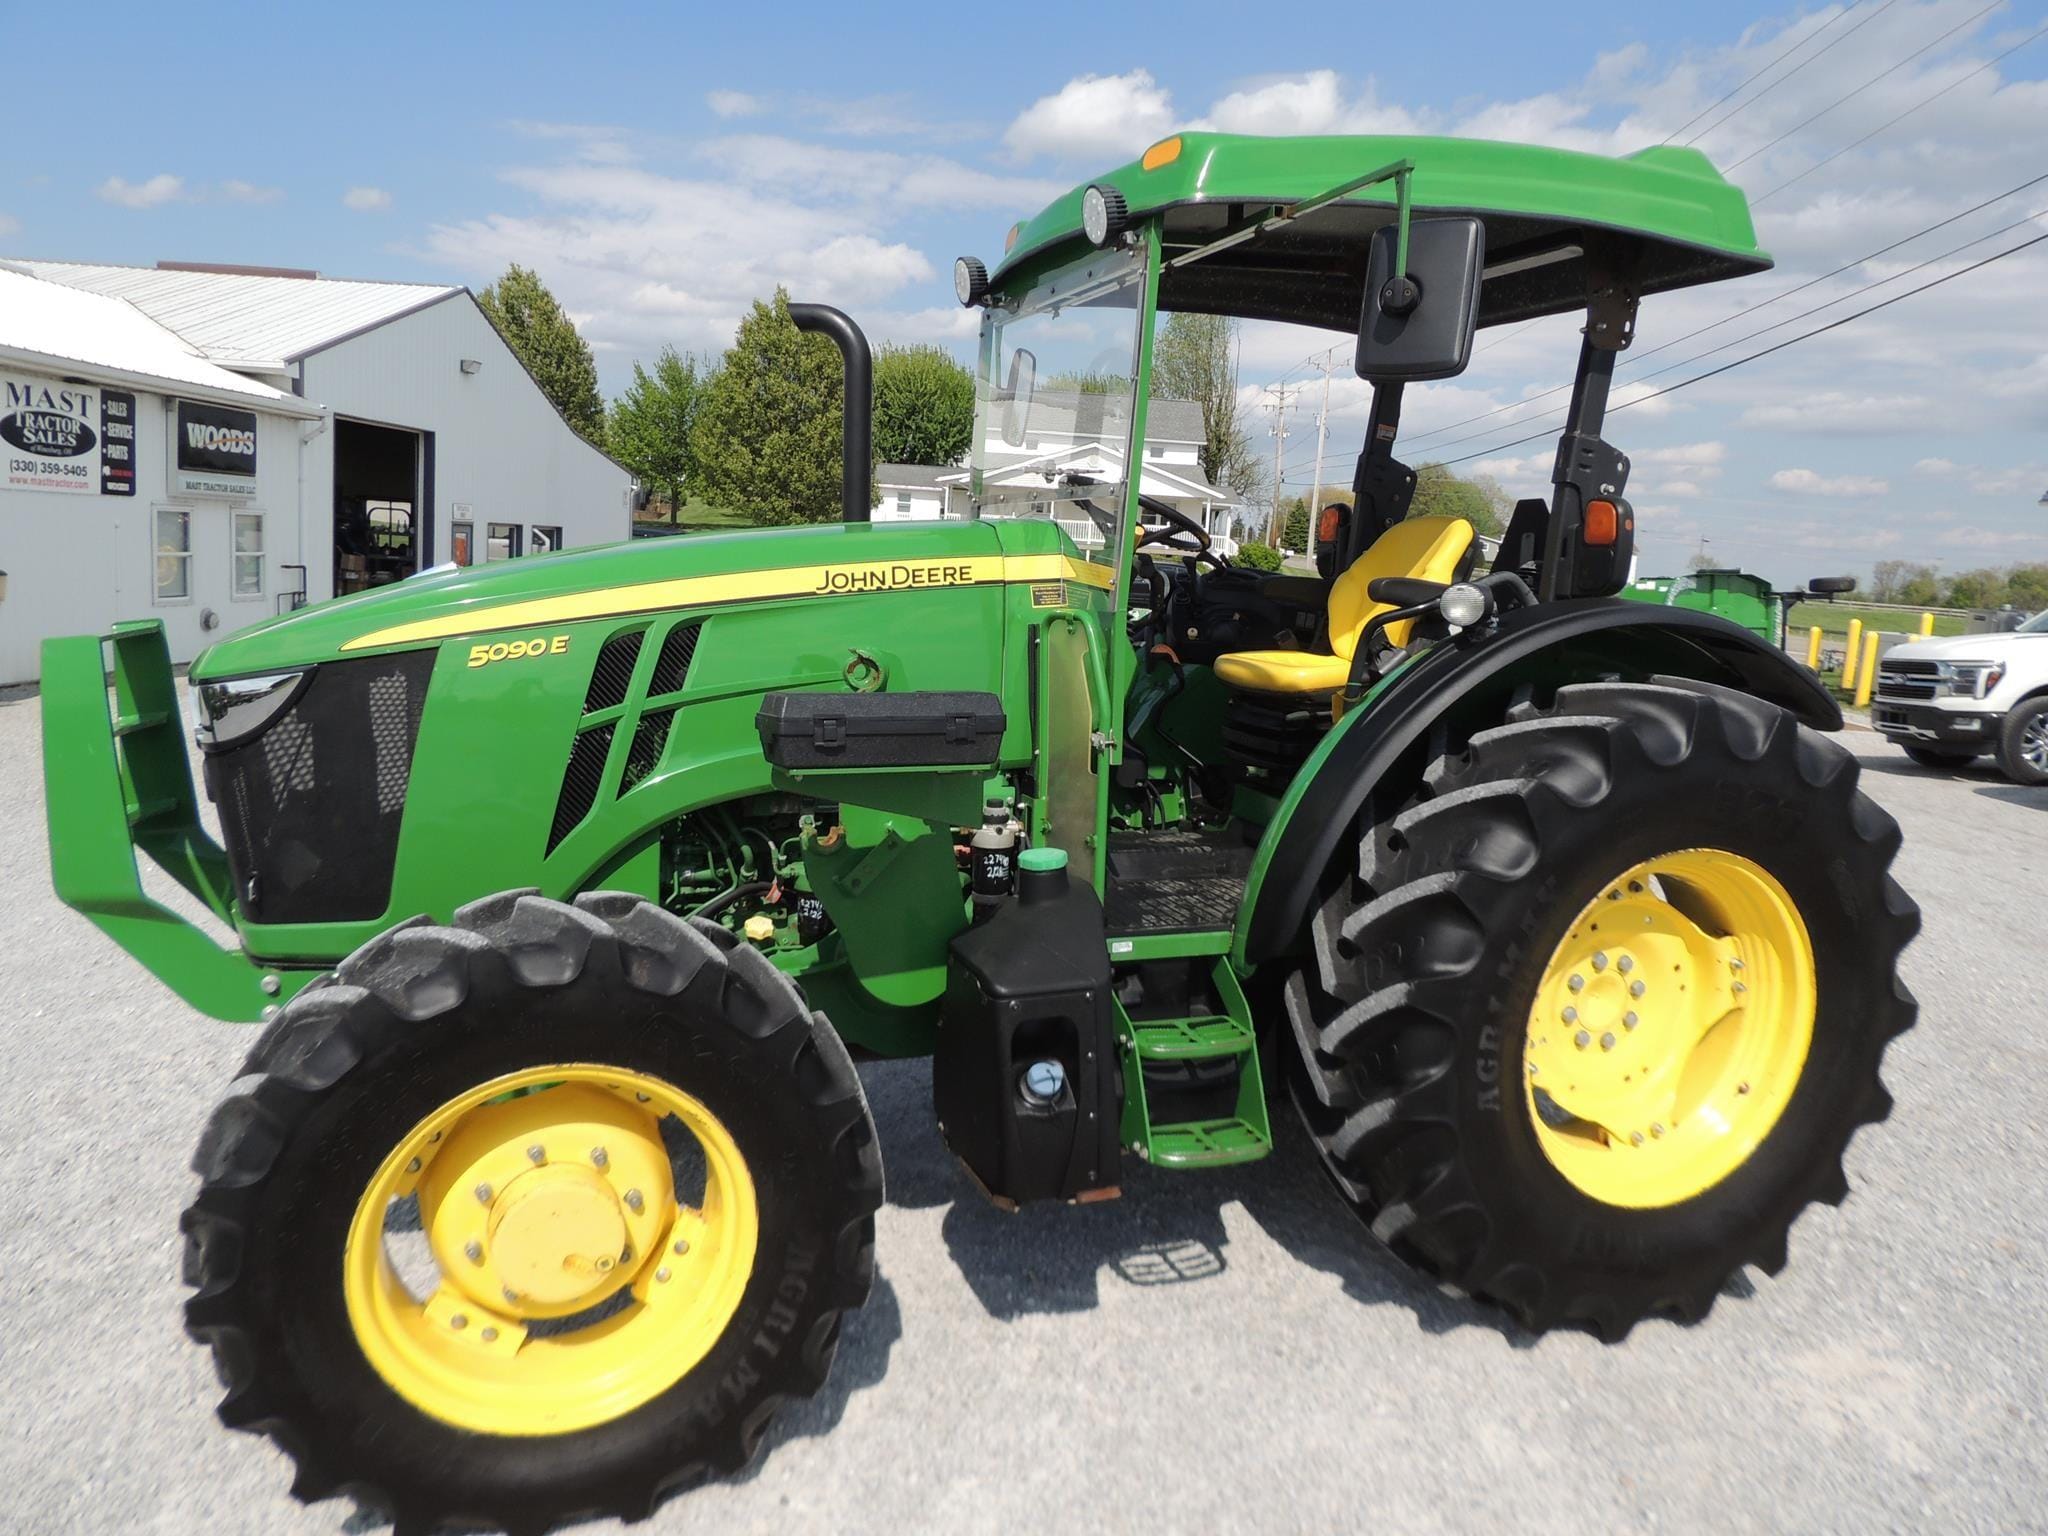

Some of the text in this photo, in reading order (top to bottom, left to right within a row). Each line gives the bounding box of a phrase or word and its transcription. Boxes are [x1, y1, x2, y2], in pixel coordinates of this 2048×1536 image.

[6, 381, 93, 419] MAST
[107, 400, 127, 417] SALES
[14, 409, 81, 434] TRACTOR
[107, 422, 133, 439] SERVICE
[23, 427, 77, 447] SALES
[187, 422, 254, 455] WOODS
[107, 444, 128, 460] PARTS
[10, 459, 88, 478] (330) 359-5405
[816, 565, 973, 591] JOHN DEERE
